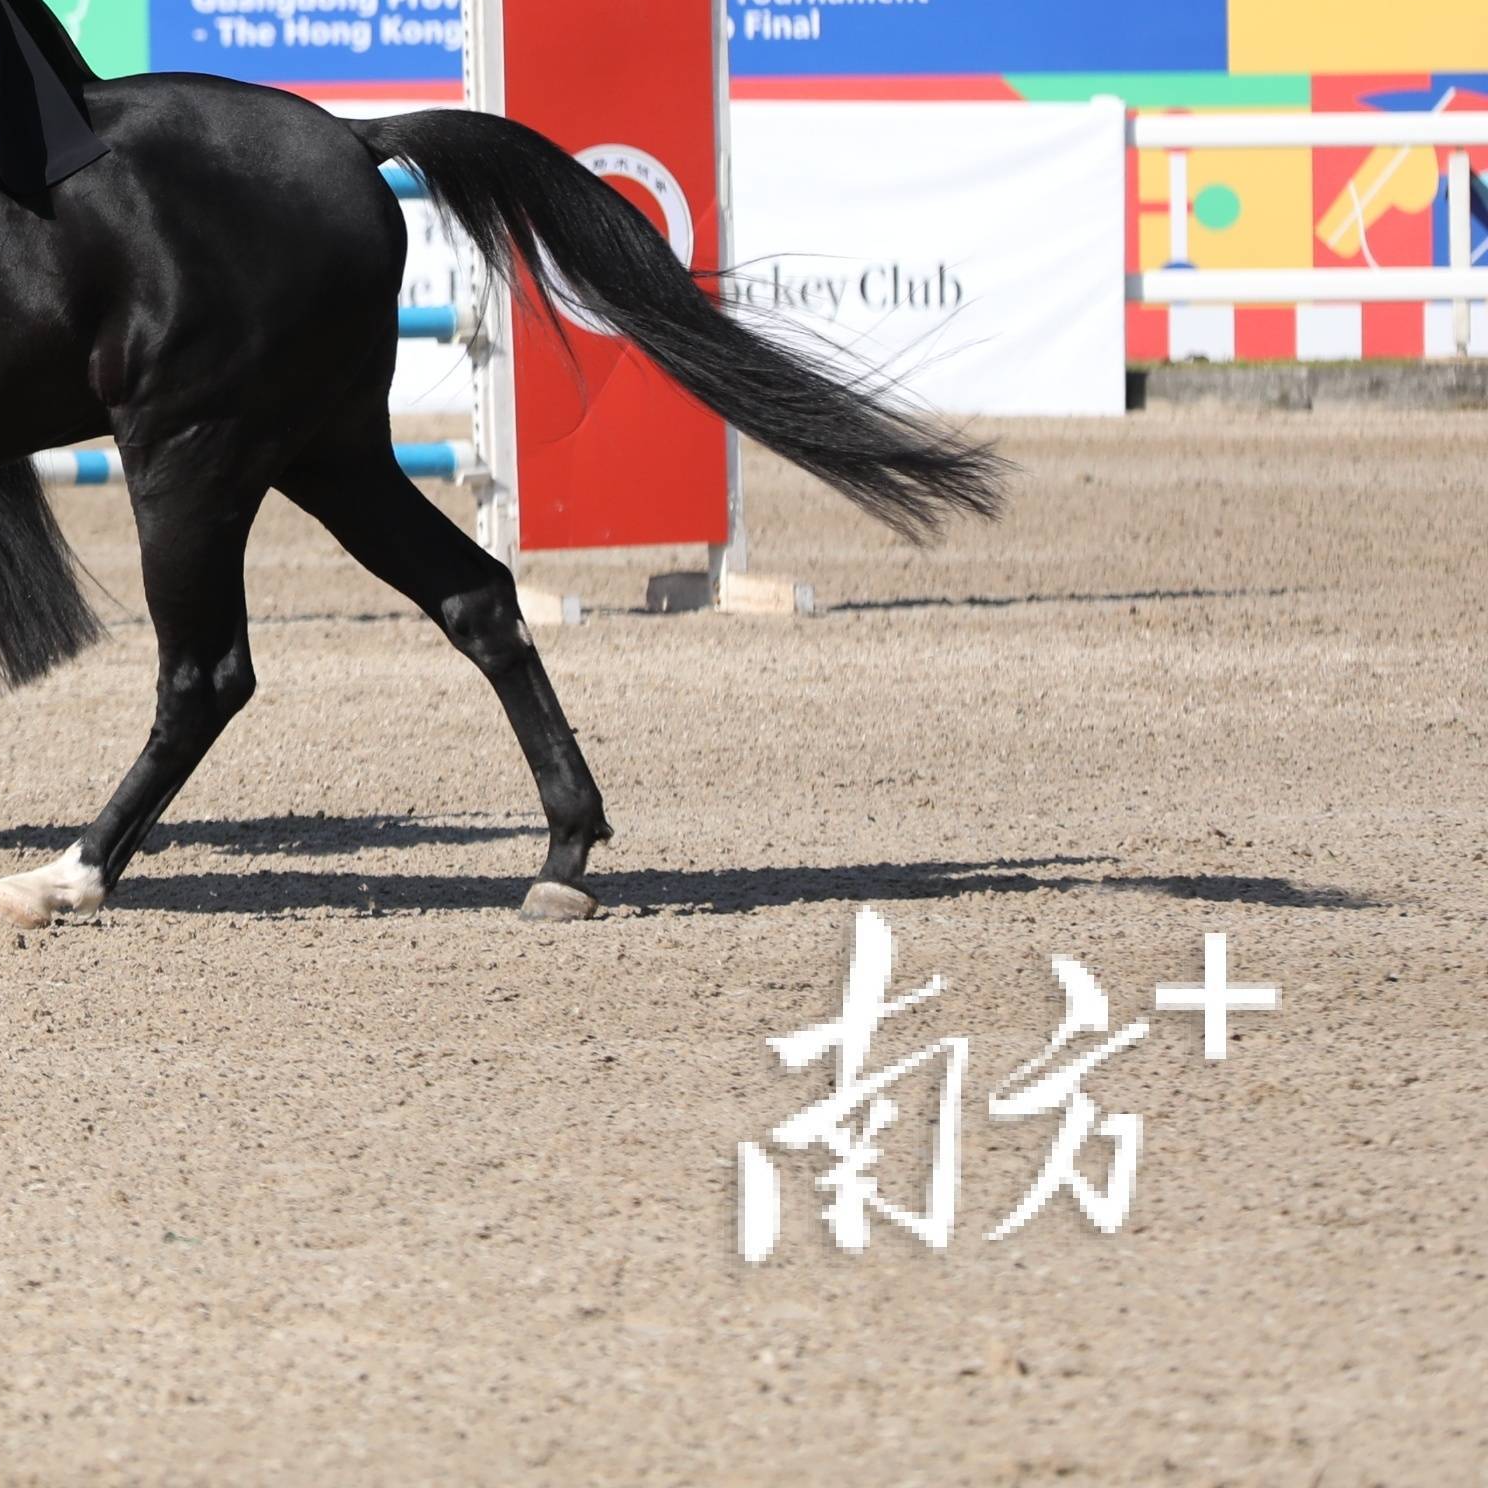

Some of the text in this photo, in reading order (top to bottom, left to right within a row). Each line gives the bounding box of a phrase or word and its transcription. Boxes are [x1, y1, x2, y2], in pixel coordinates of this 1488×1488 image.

[215, 17, 278, 48] The
[283, 15, 372, 52] Hong
[381, 13, 462, 52] Kong
[745, 7, 821, 41] Final
[859, 263, 963, 310] Club
